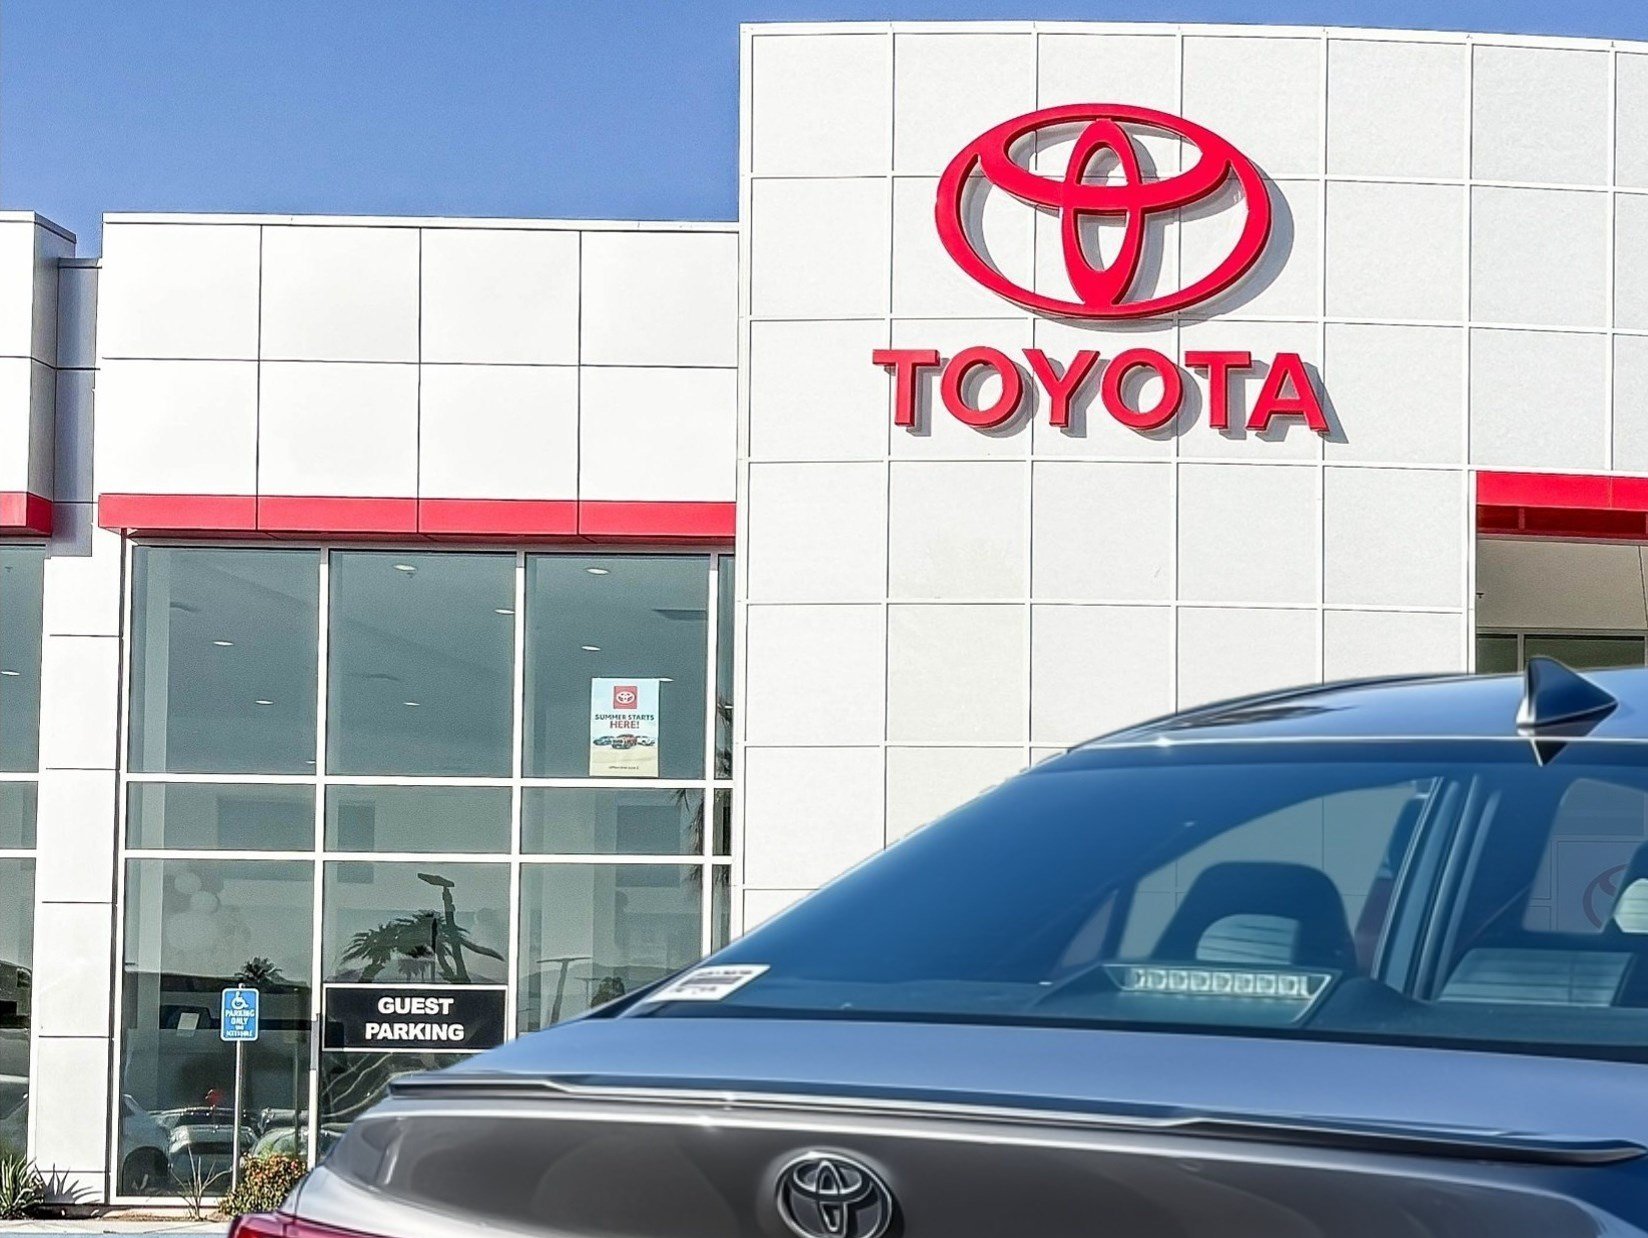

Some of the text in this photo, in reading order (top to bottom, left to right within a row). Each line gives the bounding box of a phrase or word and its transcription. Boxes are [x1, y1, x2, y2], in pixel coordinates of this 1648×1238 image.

[872, 346, 1330, 433] TOYOTA
[609, 720, 640, 729] HERE!
[377, 996, 455, 1015] GUEST
[364, 1022, 465, 1042] PARKING
